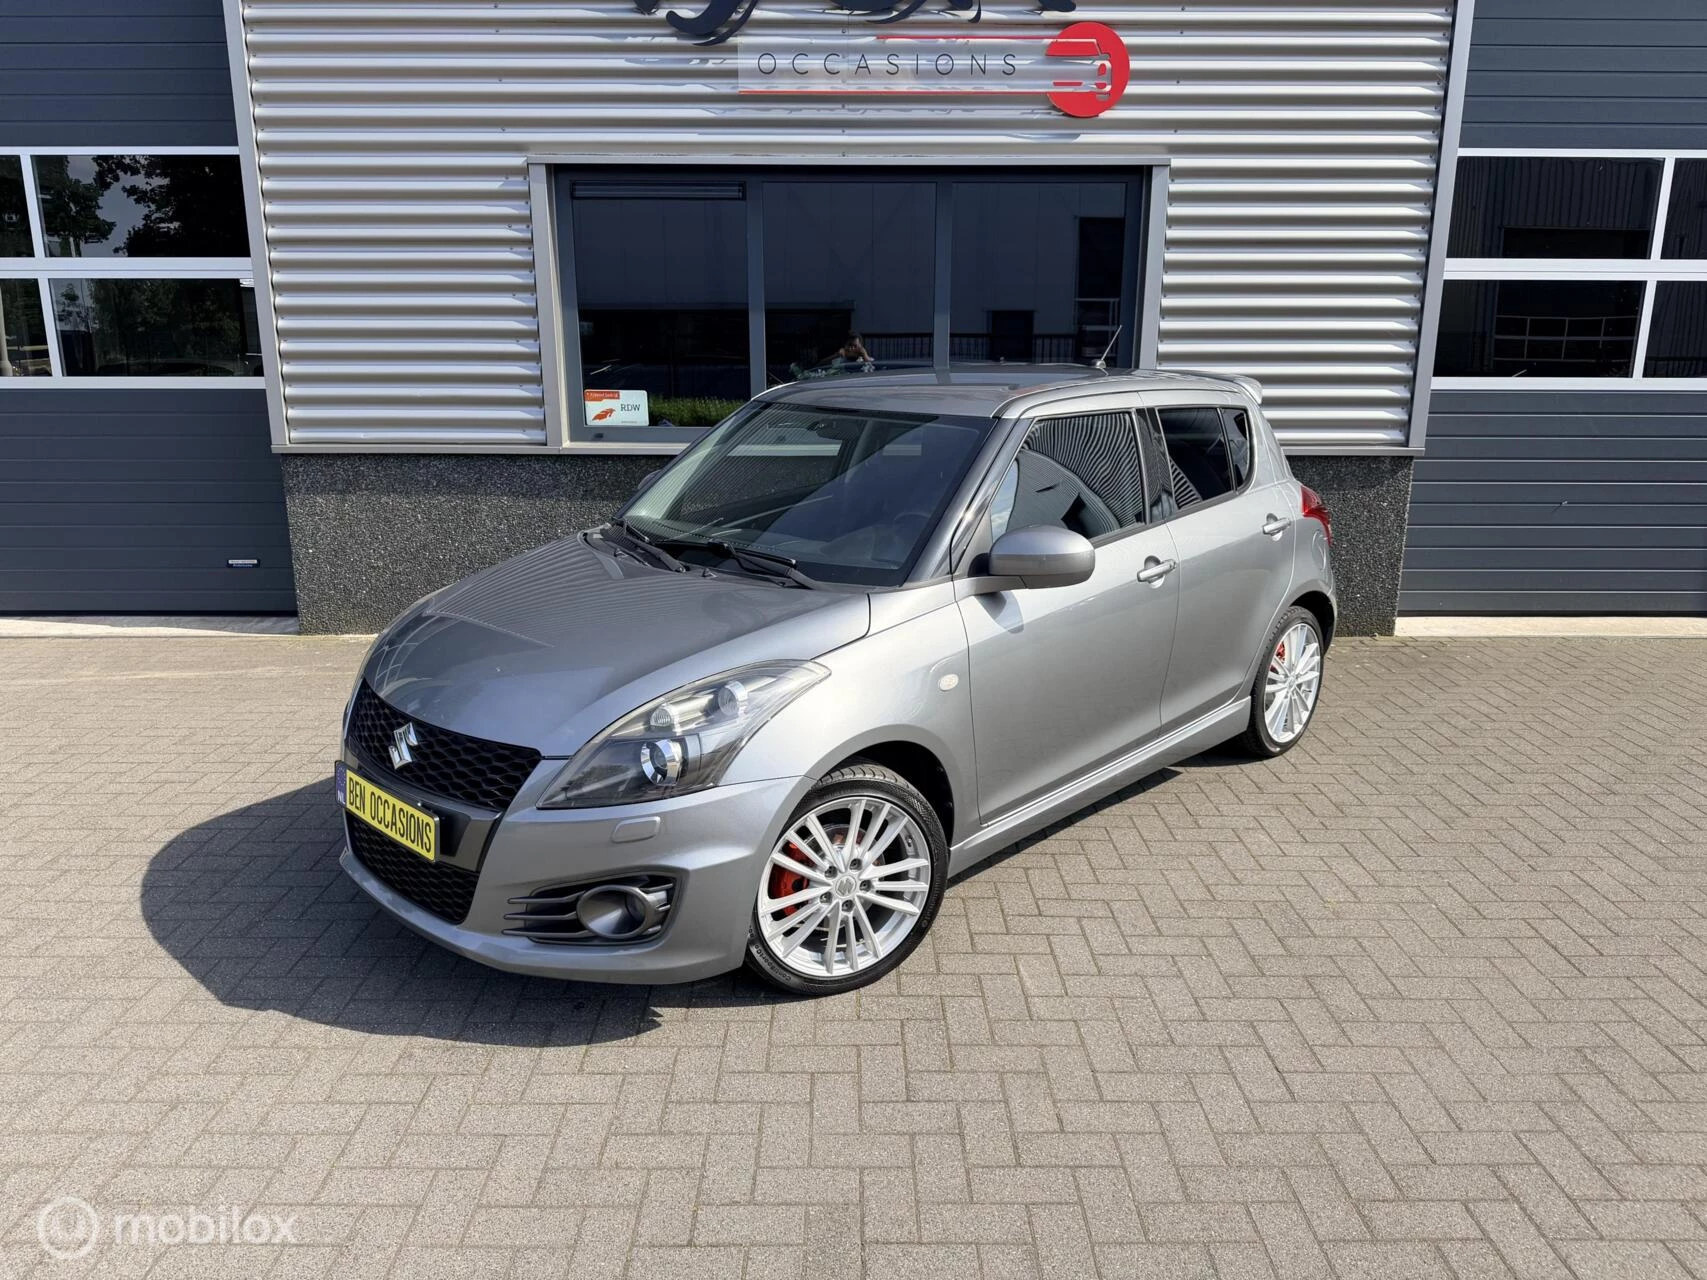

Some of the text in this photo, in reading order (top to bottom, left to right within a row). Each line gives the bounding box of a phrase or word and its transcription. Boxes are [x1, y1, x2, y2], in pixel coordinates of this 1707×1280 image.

[757, 52, 1017, 76] OCCASIONS
[620, 403, 641, 412] RDW
[349, 776, 432, 854] BEN OCCASIONS
